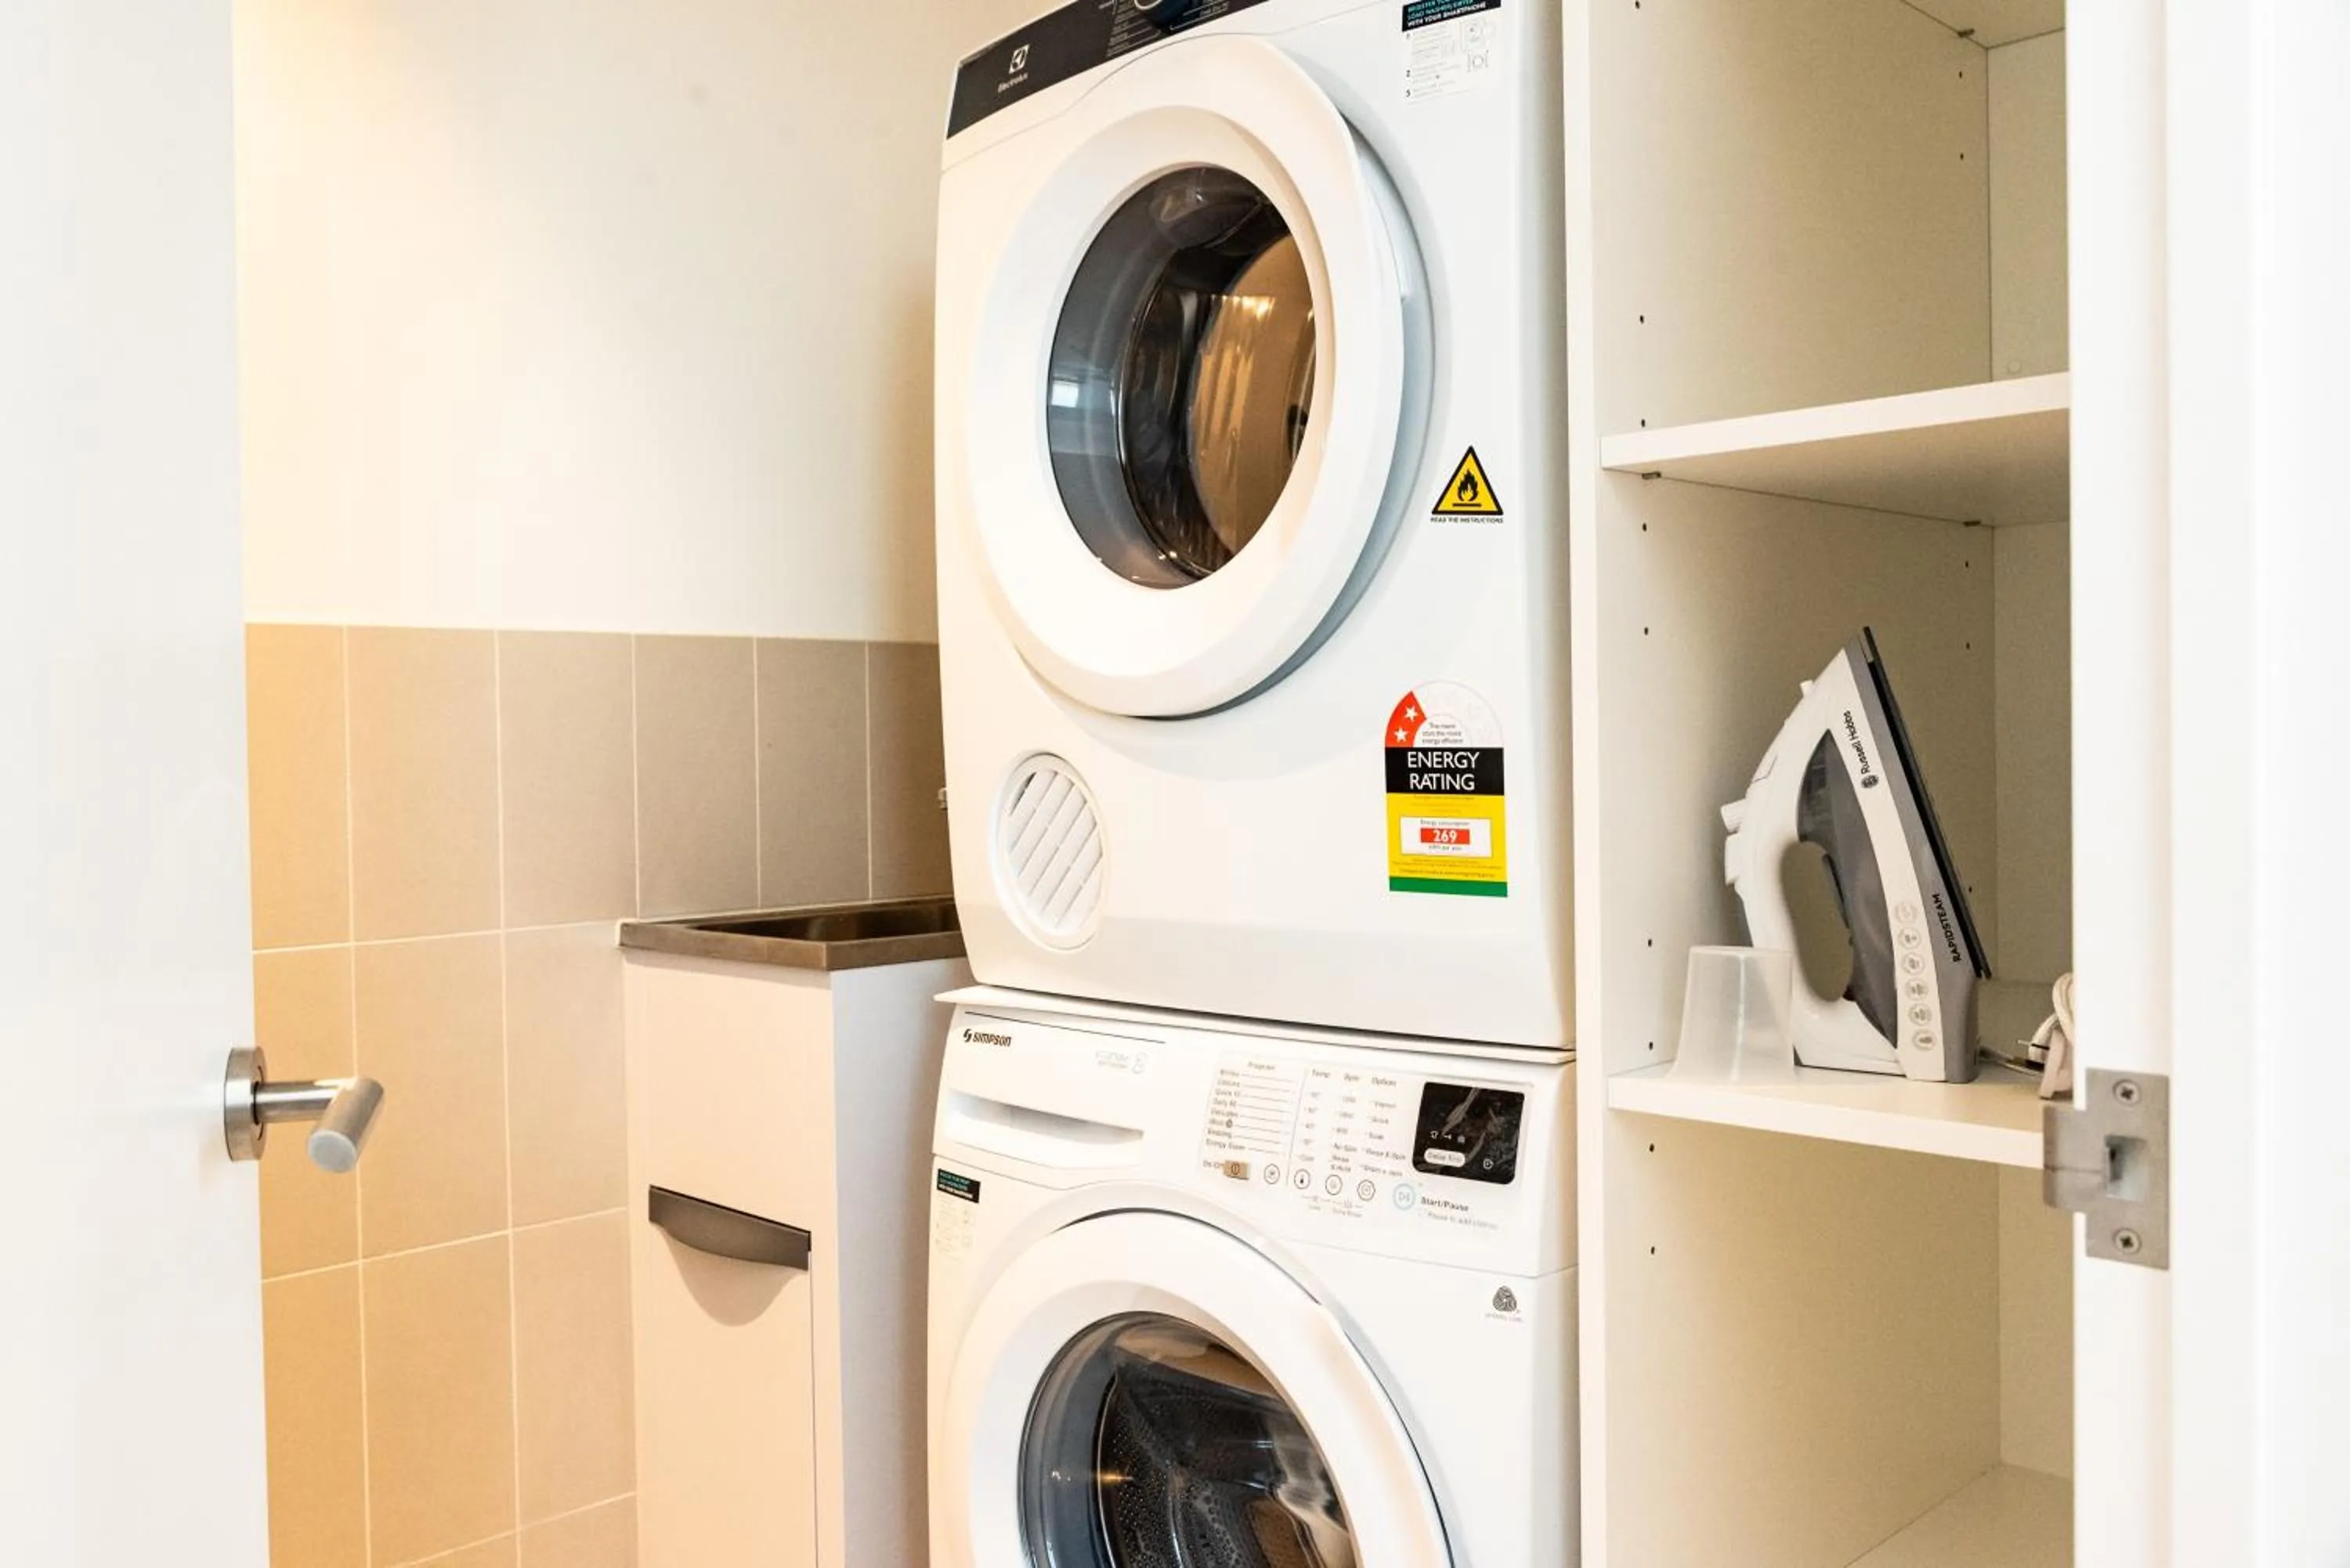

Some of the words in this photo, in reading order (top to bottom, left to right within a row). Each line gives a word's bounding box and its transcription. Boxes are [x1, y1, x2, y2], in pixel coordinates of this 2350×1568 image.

[1843, 710, 1859, 742] Hobbs
[1408, 752, 1480, 768] ENERGY
[1851, 740, 1871, 775] Russell
[1409, 773, 1475, 790] RATING
[1433, 829, 1458, 843] 269
[1932, 893, 1961, 963] RAPIDSTEAM
[1421, 1196, 1470, 1212] Start/Pause
